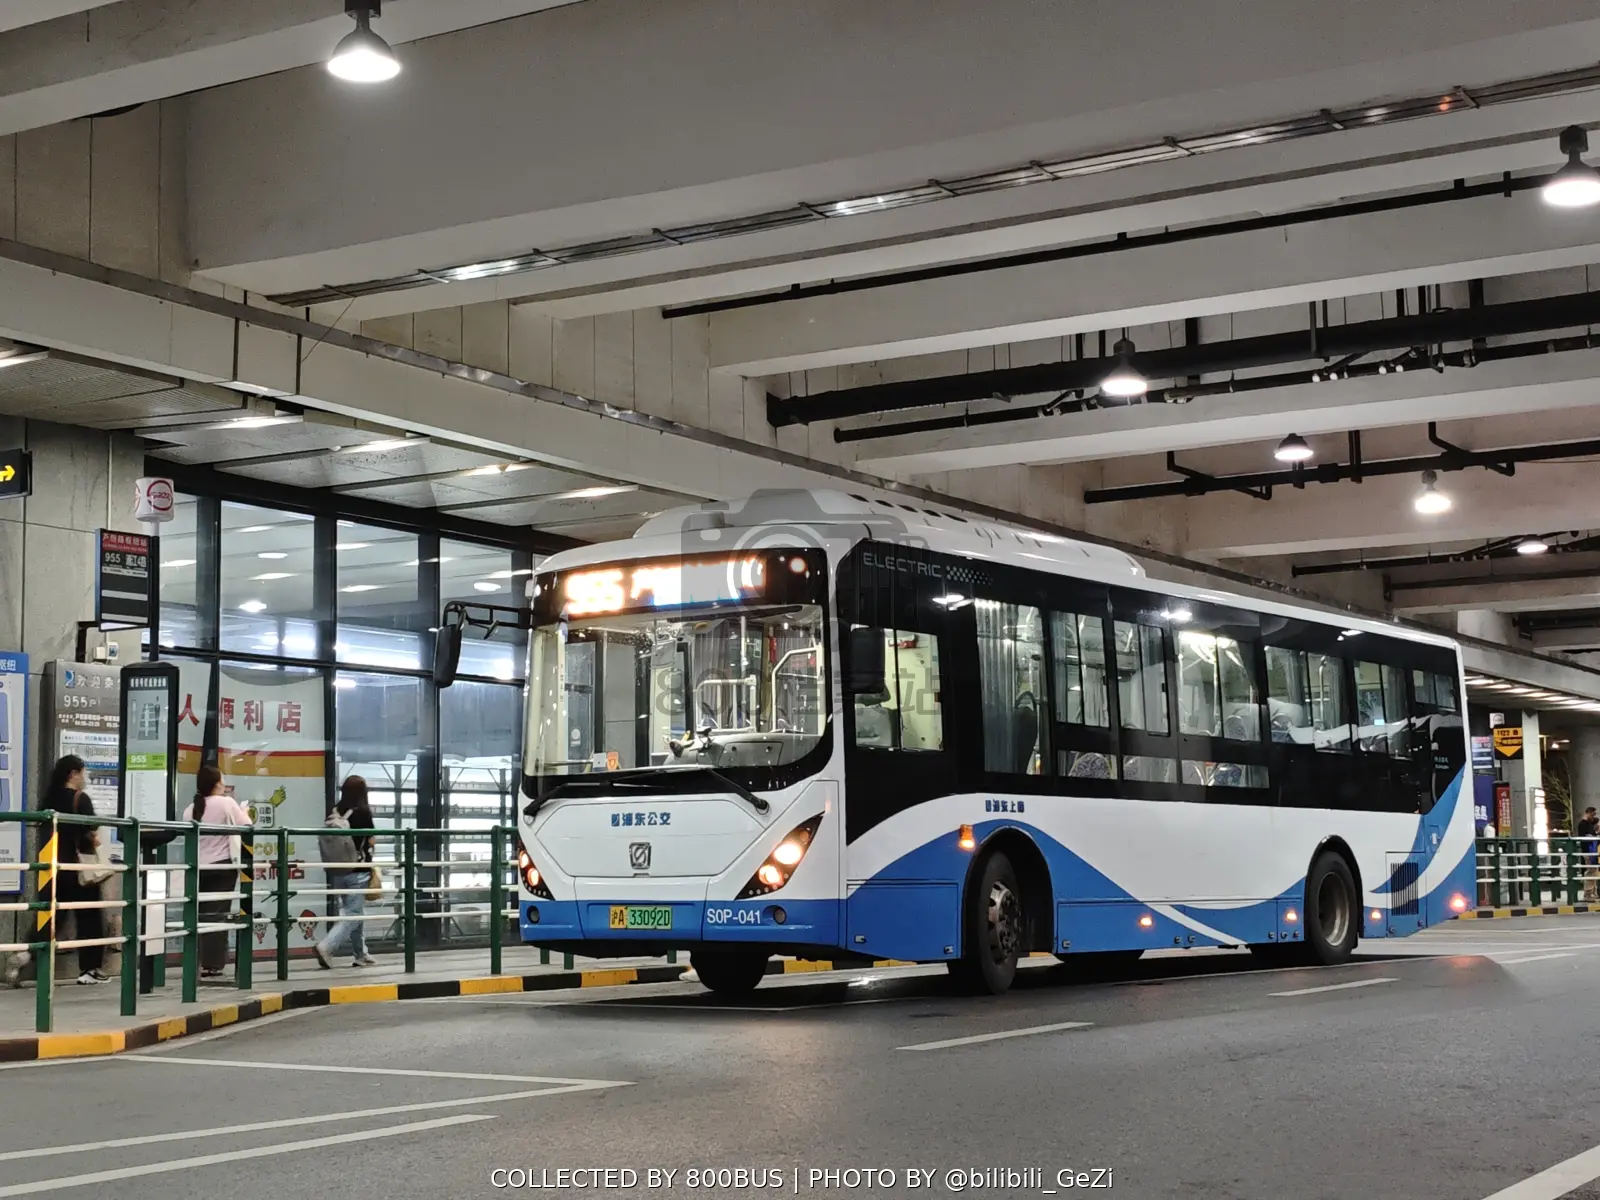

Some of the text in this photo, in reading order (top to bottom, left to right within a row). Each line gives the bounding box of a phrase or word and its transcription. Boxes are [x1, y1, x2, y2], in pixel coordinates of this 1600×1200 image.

[105, 552, 121, 563] 955
[863, 552, 942, 577] ELECTRIC
[63, 694, 88, 709] 955
[130, 754, 147, 764] 955
[622, 812, 671, 827] 浦东公交
[629, 908, 671, 926] 33092D
